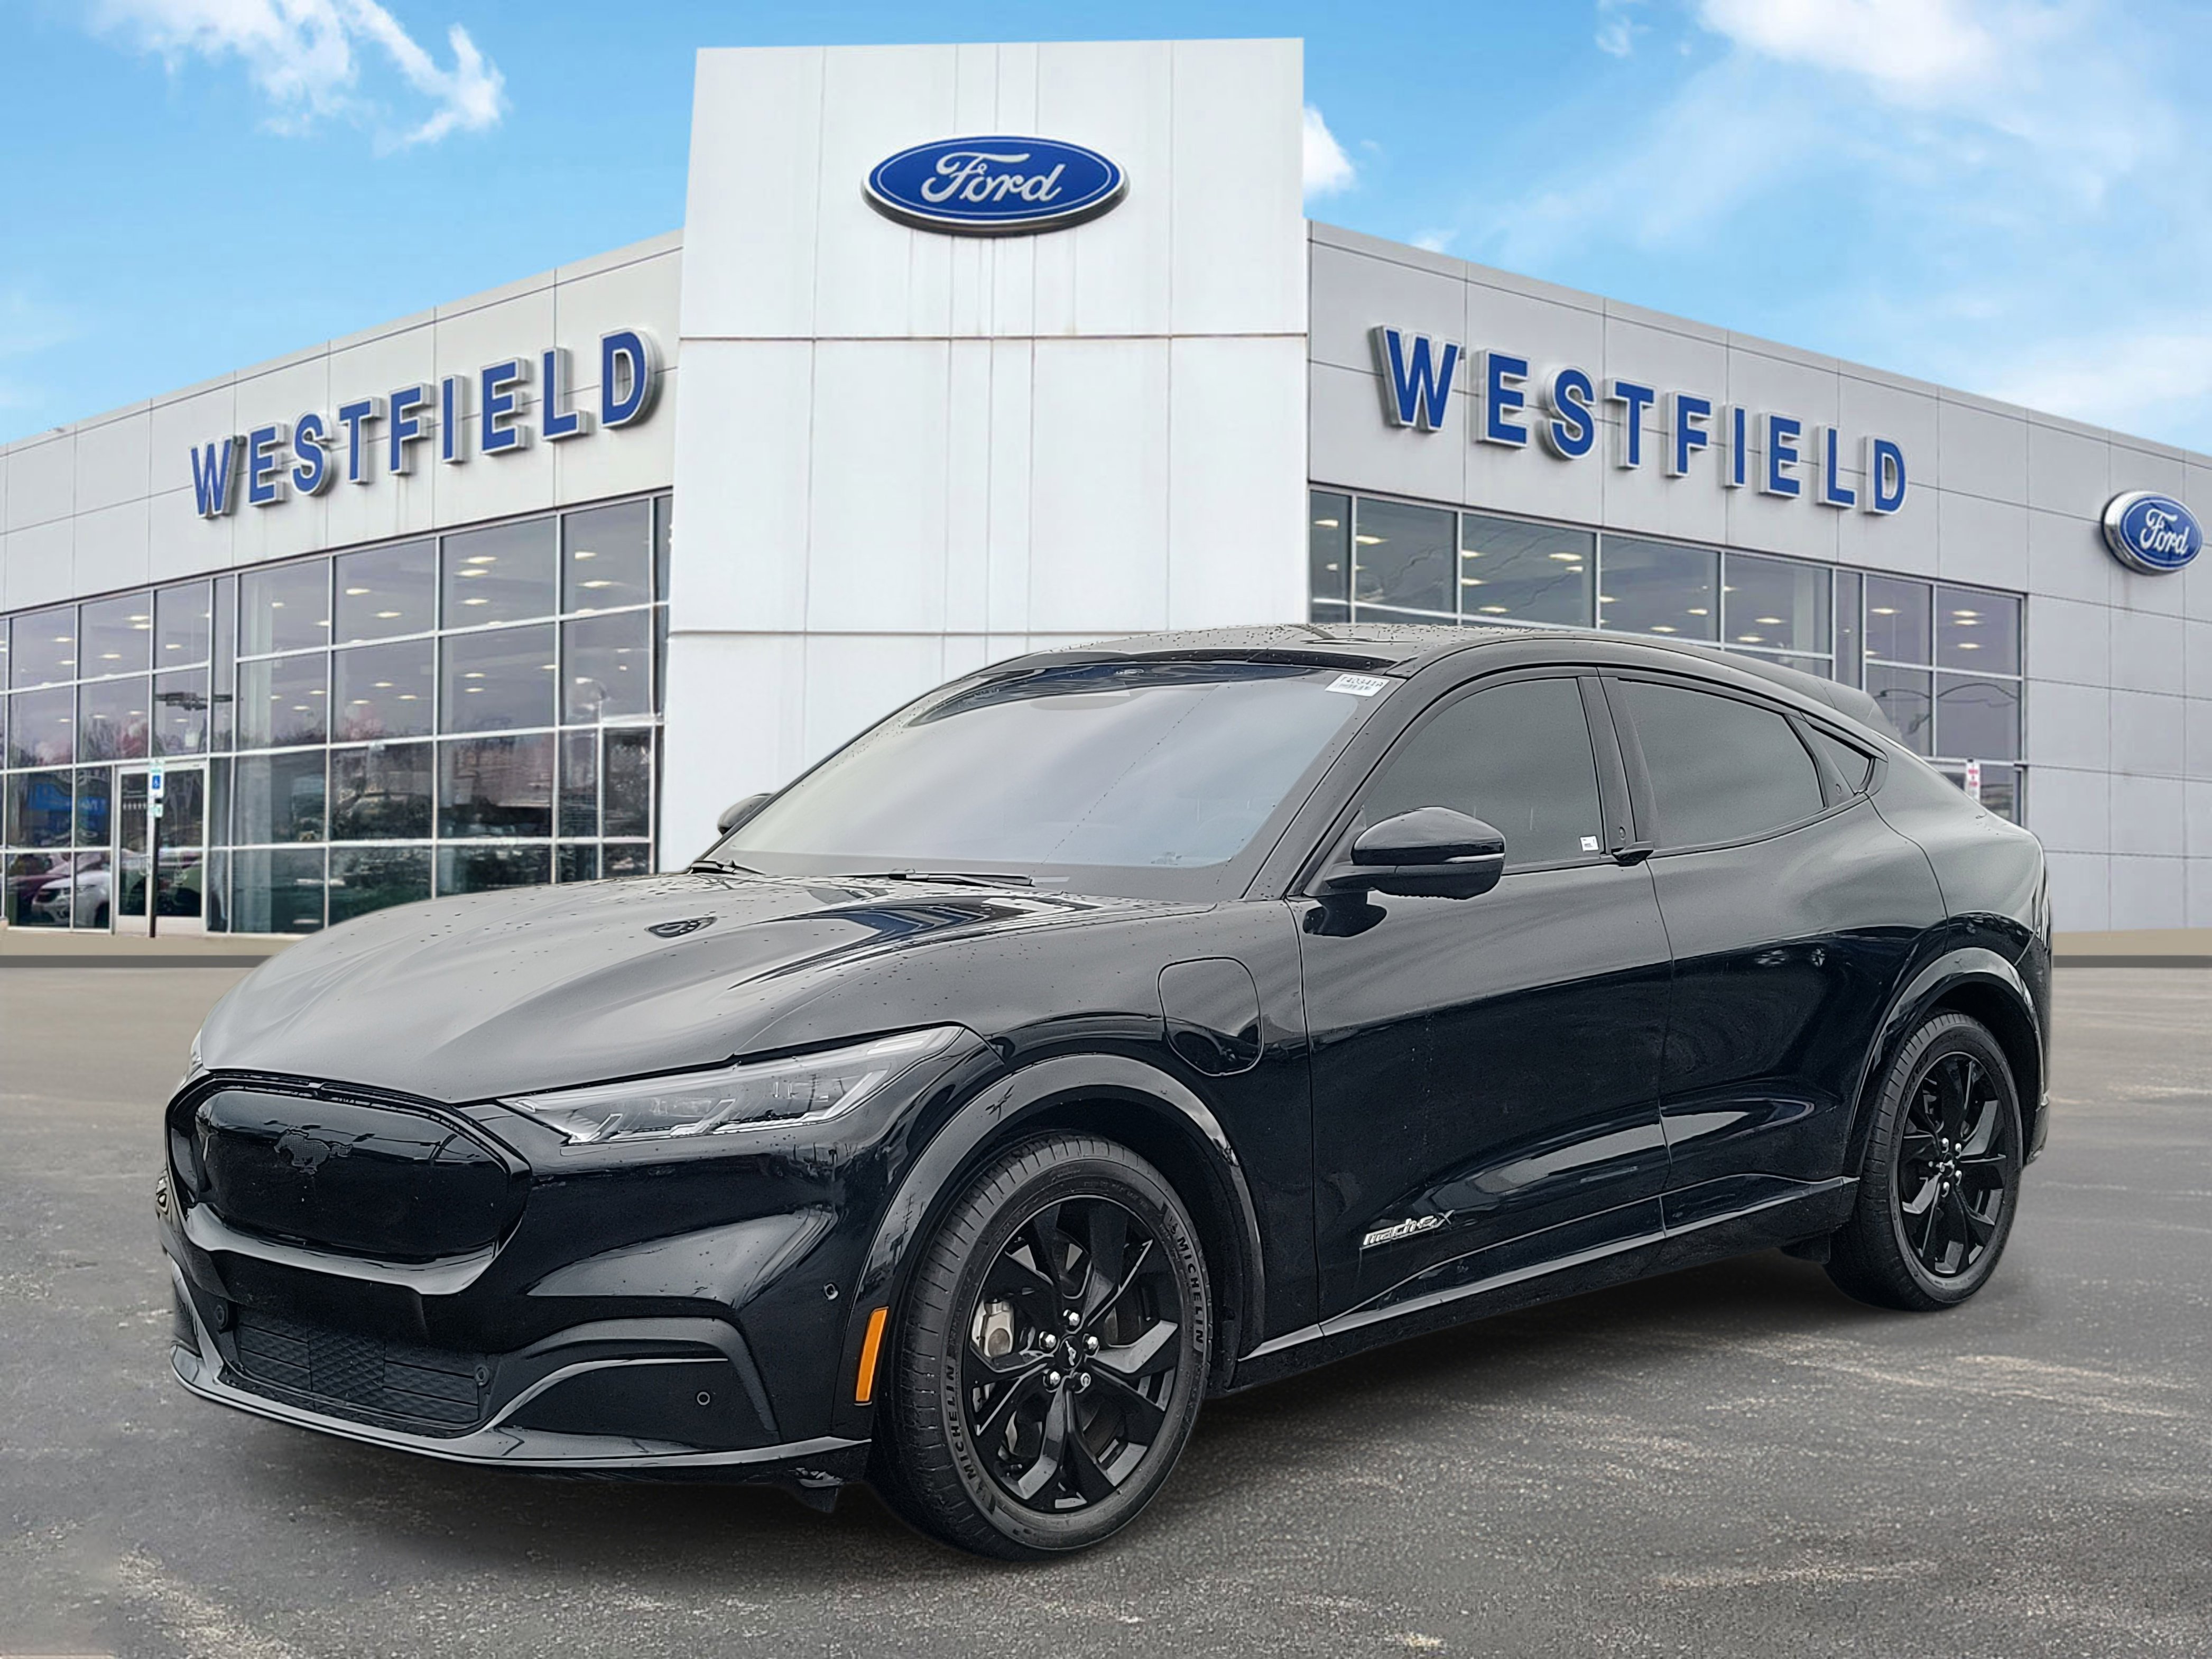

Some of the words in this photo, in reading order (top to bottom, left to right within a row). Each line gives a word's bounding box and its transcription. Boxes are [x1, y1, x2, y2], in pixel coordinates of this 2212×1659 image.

[921, 152, 1066, 202] Ford
[190, 328, 655, 518] WESTFIELD
[1373, 325, 1907, 515] WESTFIELD
[2140, 508, 2190, 555] Ford
[1177, 1236, 1204, 1343] MICHELIN
[946, 1365, 977, 1480] MICHELIN
